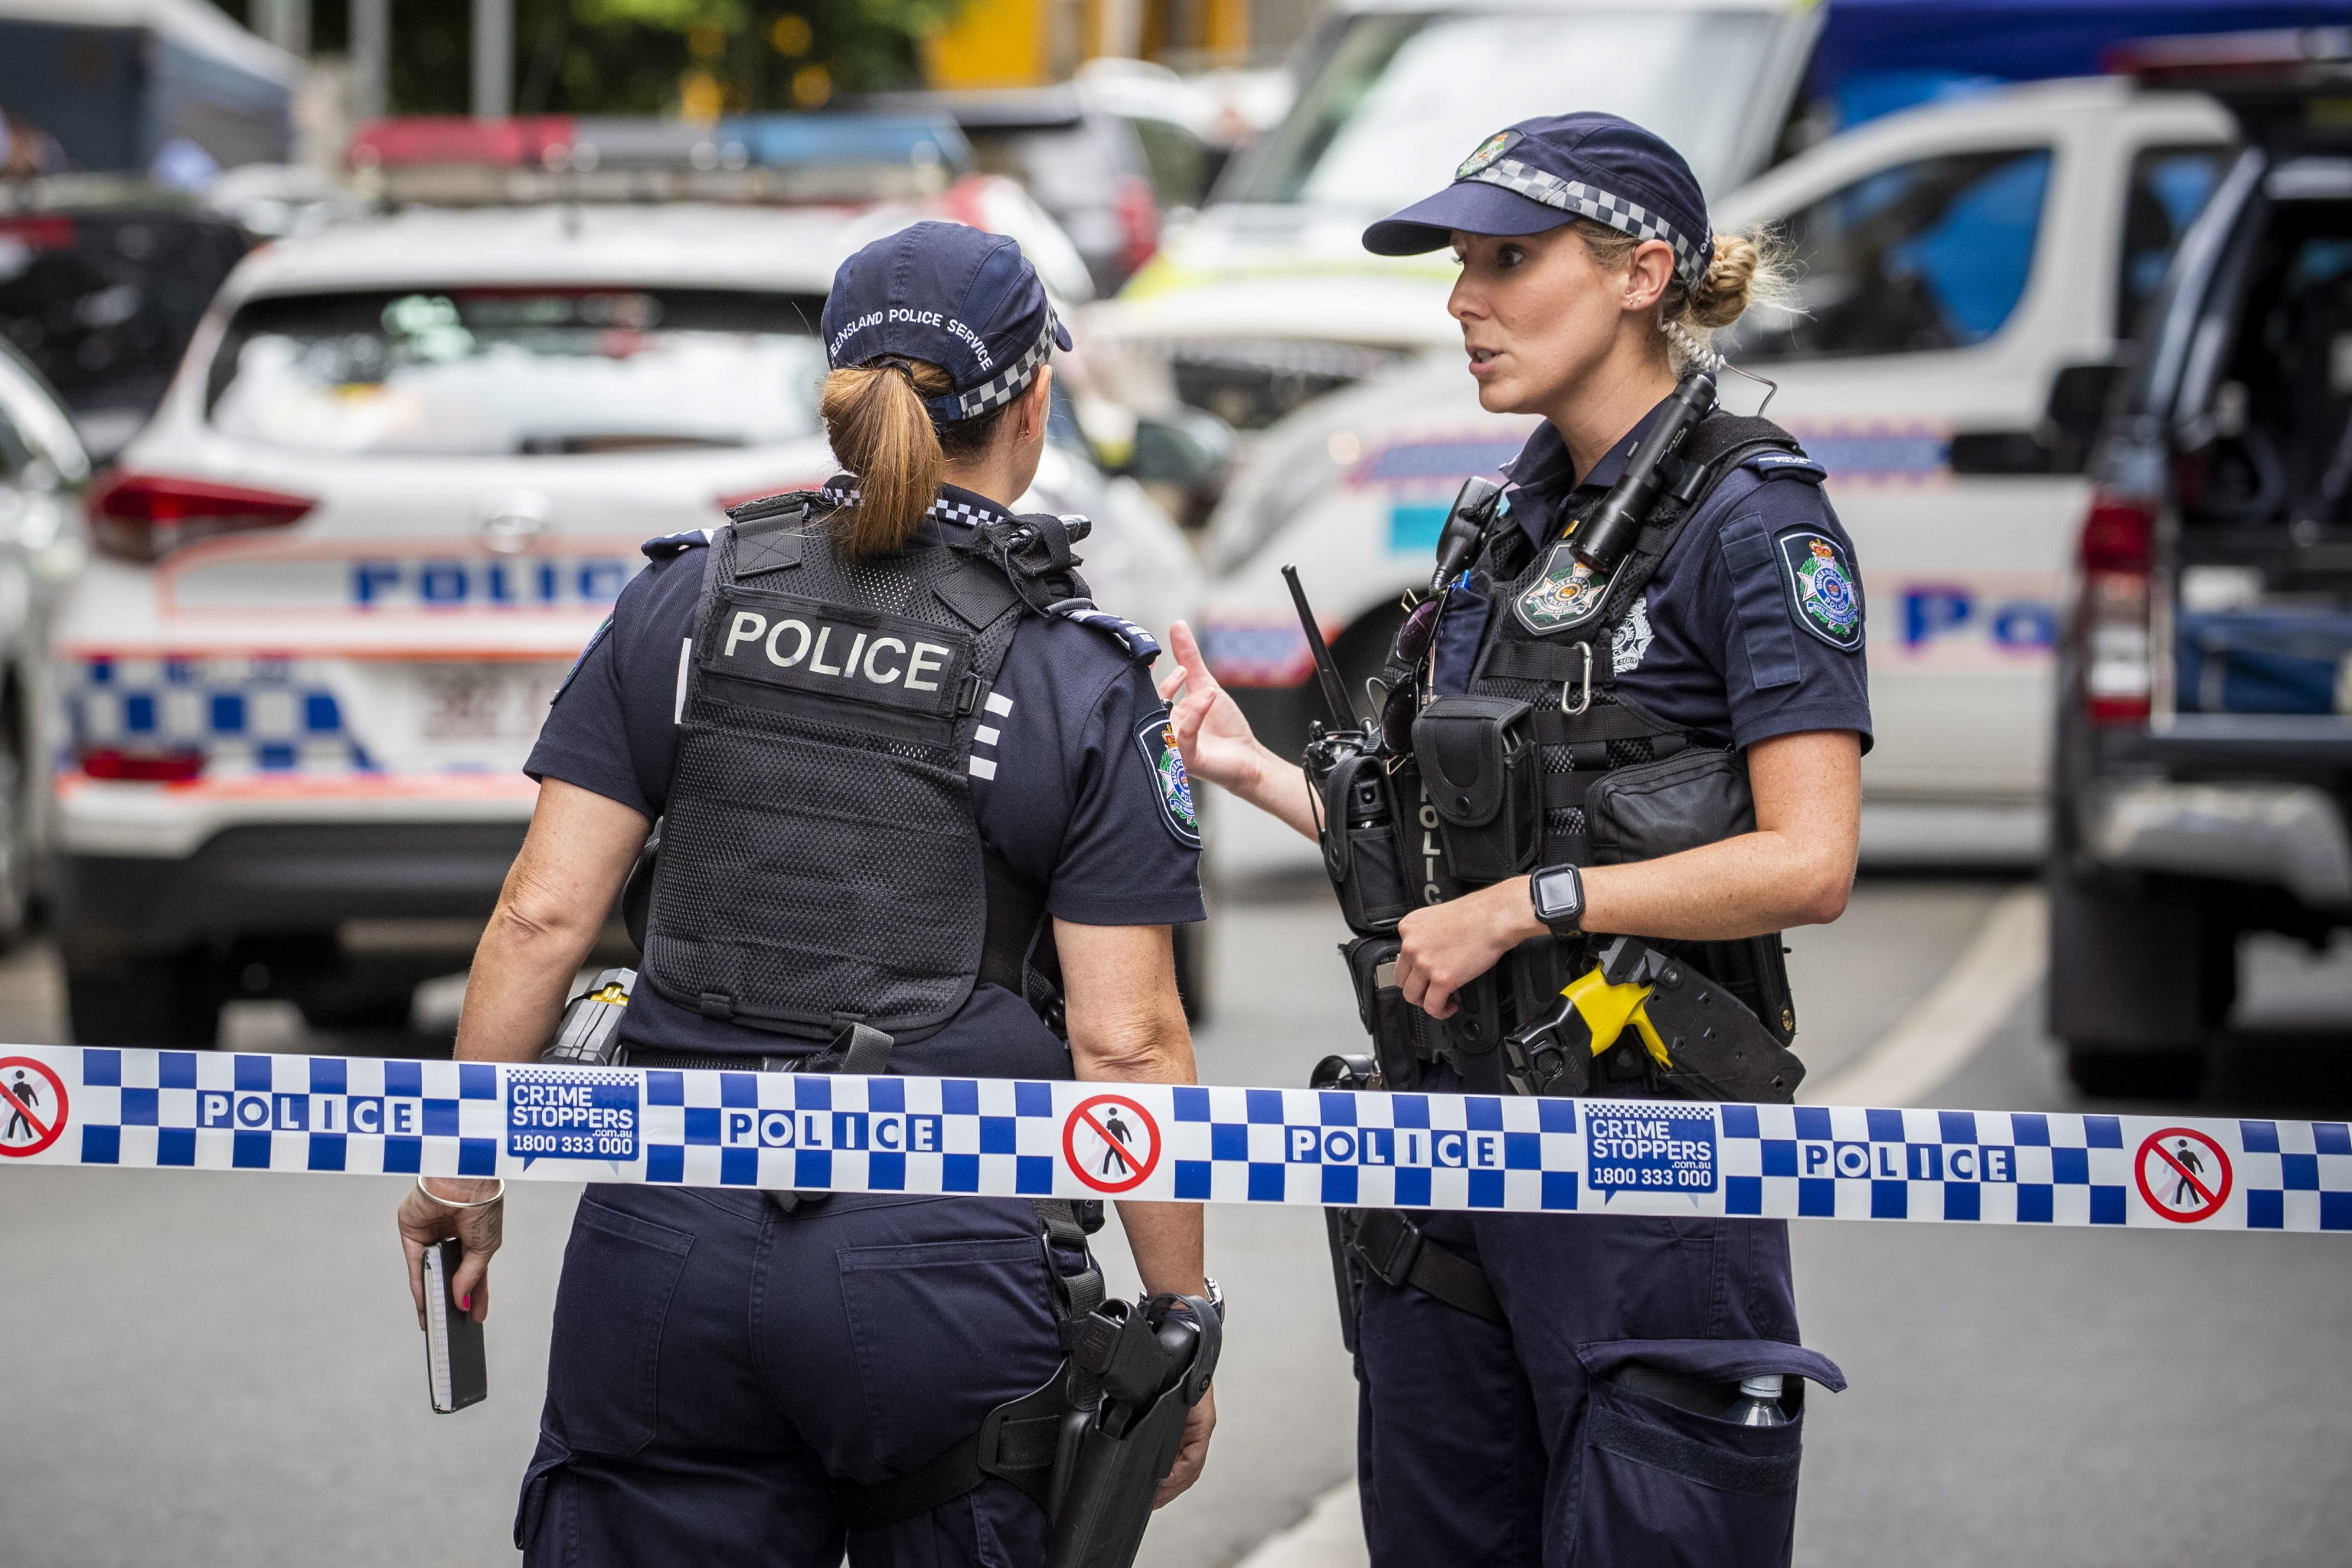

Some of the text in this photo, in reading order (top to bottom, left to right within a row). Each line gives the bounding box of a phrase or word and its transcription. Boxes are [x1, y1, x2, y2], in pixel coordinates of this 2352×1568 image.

[829, 309, 994, 372] EENSLAND POLICE SERVICE
[354, 560, 628, 608] POLIC
[1816, 569, 1847, 594] QUEENSLAND
[1825, 596, 1847, 610] POLICE
[724, 611, 949, 691] POLICE
[1419, 777, 1442, 906] OLIC
[513, 1085, 593, 1107] CRIME
[204, 1094, 412, 1133] POLICE
[512, 1106, 634, 1129] STOPPERS
[592, 1129, 632, 1138] .com.au
[730, 1112, 933, 1152] POLICE
[1592, 1119, 1671, 1140] CRIME
[513, 1135, 632, 1155] 1800 333 000
[1292, 1129, 1494, 1167] POLICE
[1592, 1138, 1712, 1161] STOPPERS
[1671, 1161, 1711, 1170] .com.au
[1805, 1144, 2007, 1181] POLICE
[1594, 1168, 1712, 1187] 1800 333 000
